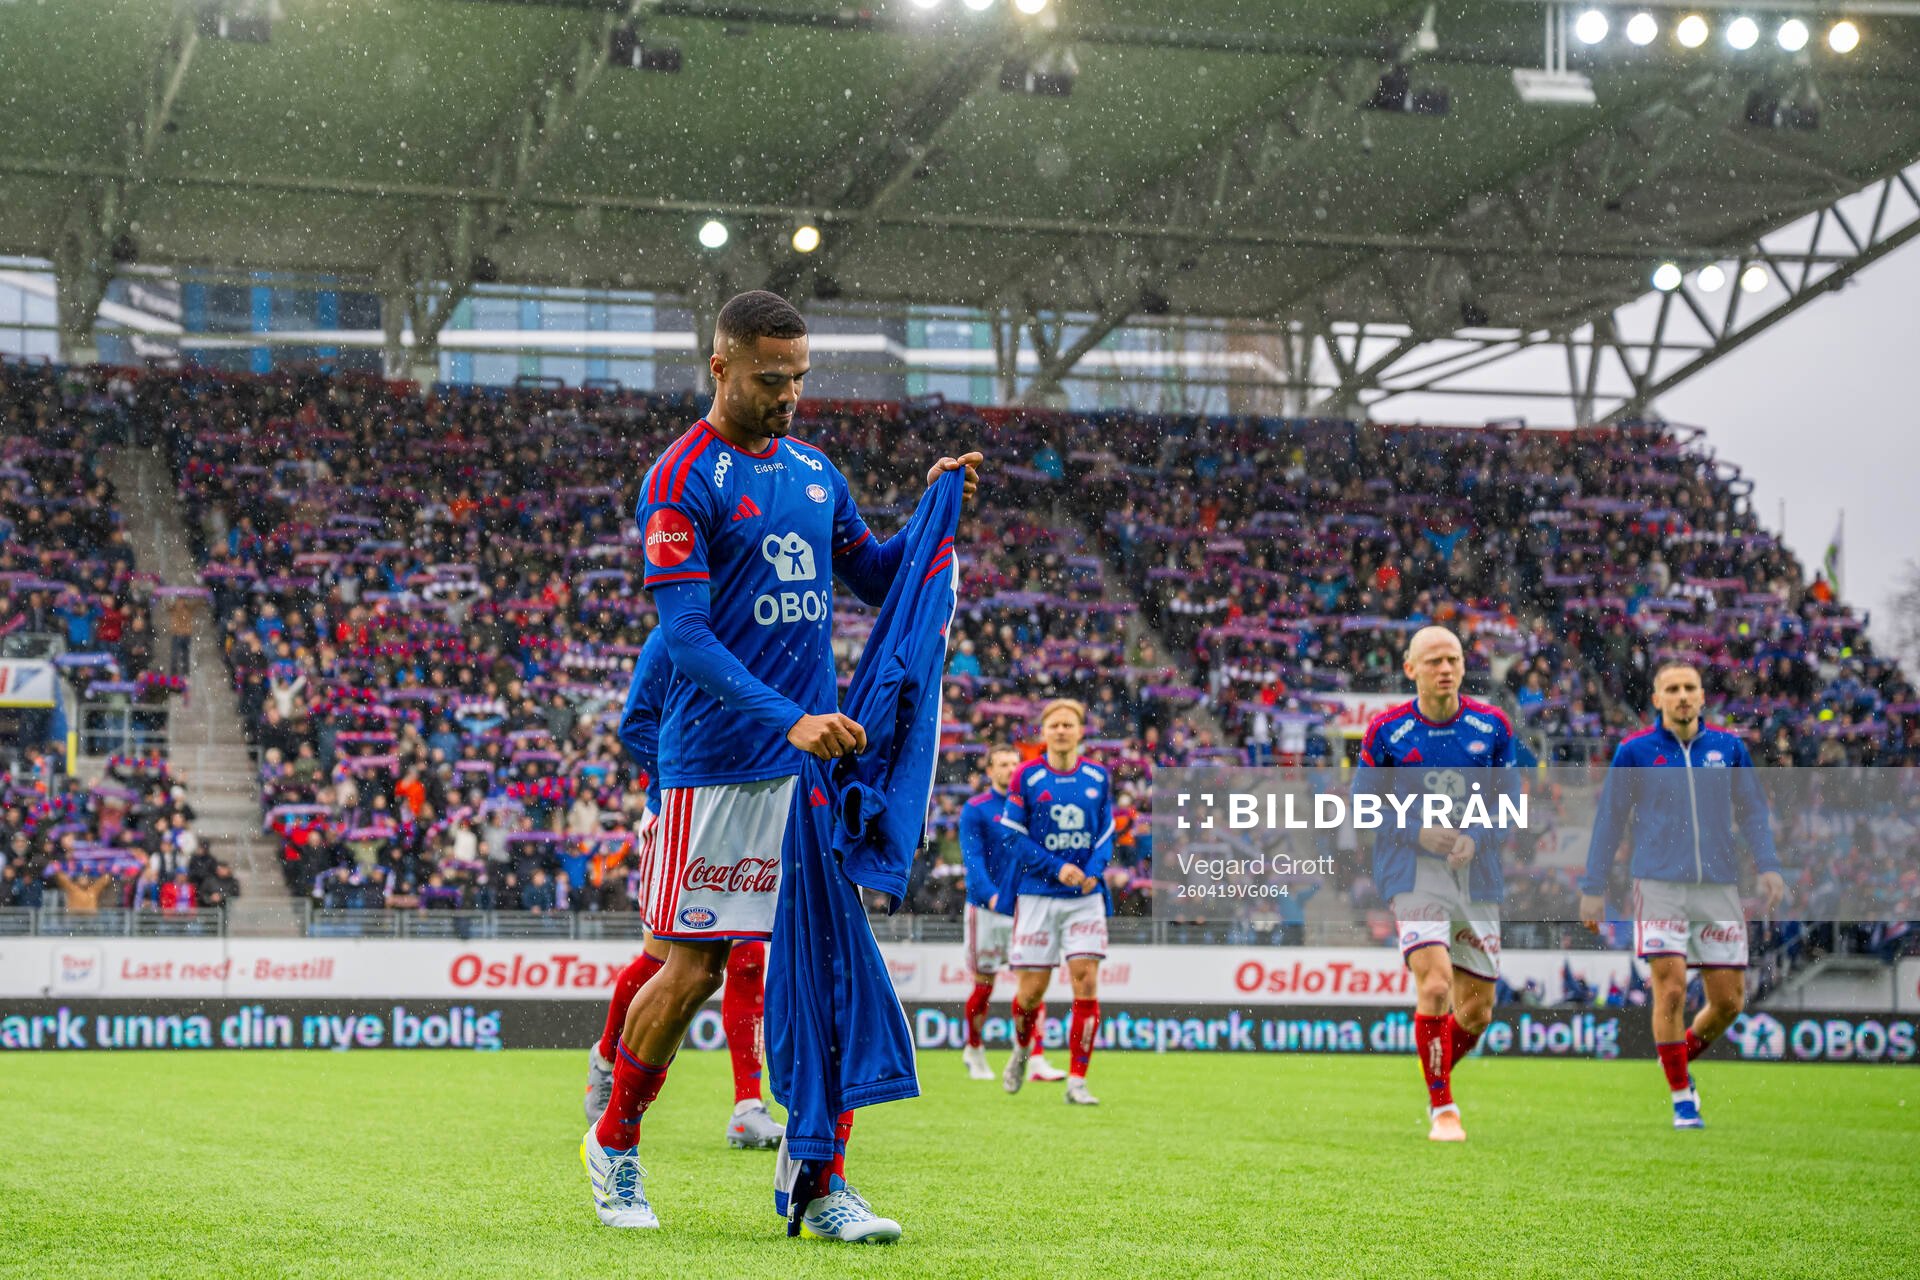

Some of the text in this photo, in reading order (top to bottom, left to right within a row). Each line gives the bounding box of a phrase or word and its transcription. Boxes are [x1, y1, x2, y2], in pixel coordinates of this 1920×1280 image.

[647, 530, 688, 546] altibox
[754, 590, 828, 626] OBOS
[682, 857, 780, 893] Coca-Cola
[121, 958, 174, 981] Last
[180, 957, 232, 981] ned
[254, 958, 334, 981] Bestill
[449, 953, 629, 989] OsloTax
[1234, 960, 1408, 995] OsloTaxi
[97, 1015, 213, 1048] unna
[221, 1005, 293, 1048] din
[302, 1014, 384, 1052] nye
[393, 1005, 501, 1052] bolig
[1095, 1012, 1254, 1053] utspark
[1262, 1017, 1364, 1050] unna
[1520, 1013, 1621, 1059] bolig
[1791, 1019, 1916, 1059] OBOS
